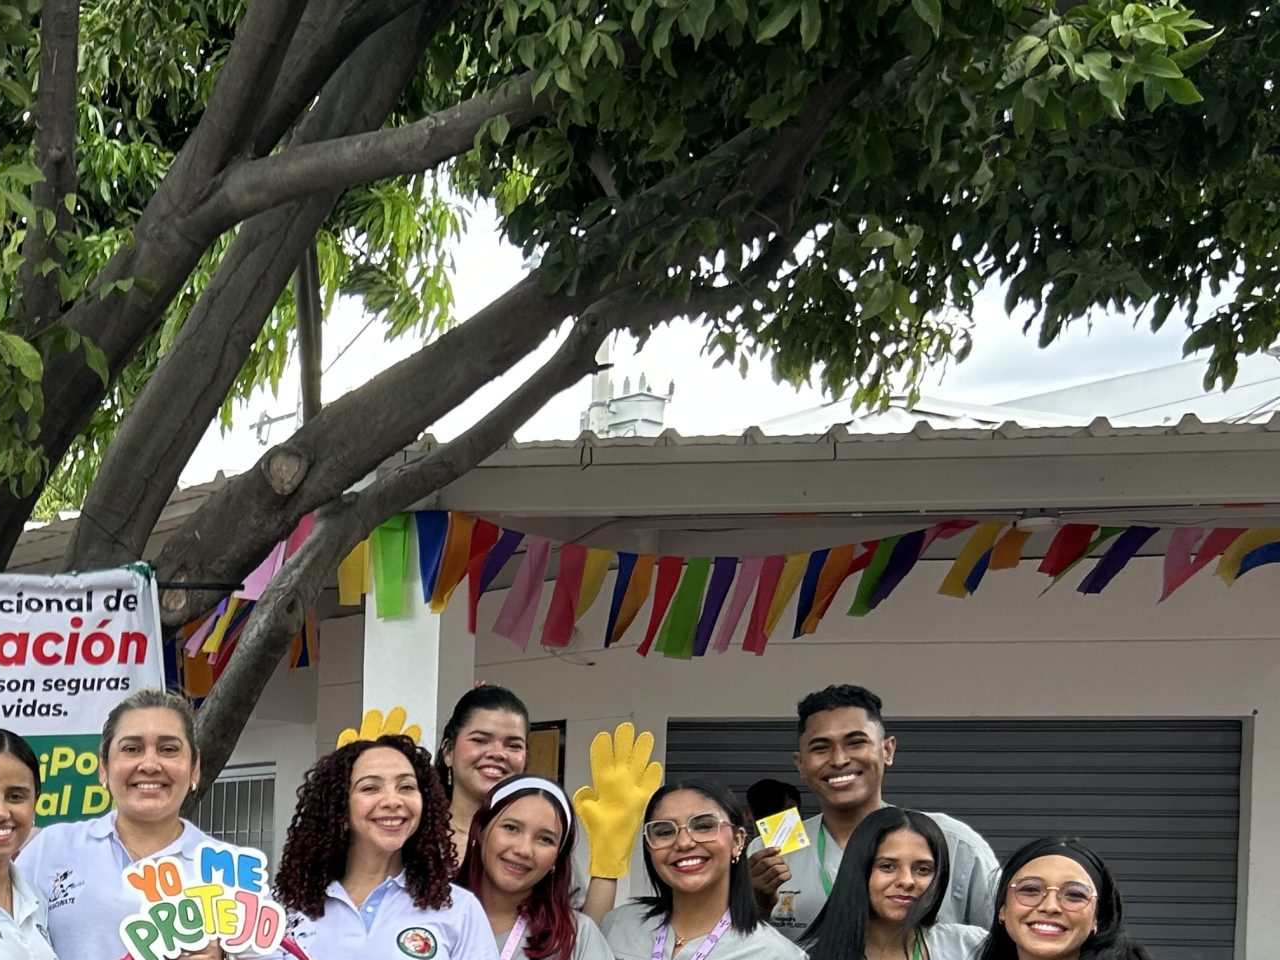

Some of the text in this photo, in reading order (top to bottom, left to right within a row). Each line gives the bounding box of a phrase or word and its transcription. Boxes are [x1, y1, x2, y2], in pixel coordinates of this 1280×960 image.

[103, 588, 138, 613] de
[42, 676, 130, 696] seguras
[1, 698, 69, 718] vidas.
[39, 746, 99, 783] ¡Po
[35, 784, 115, 817] al D
[127, 846, 263, 903] YO ME
